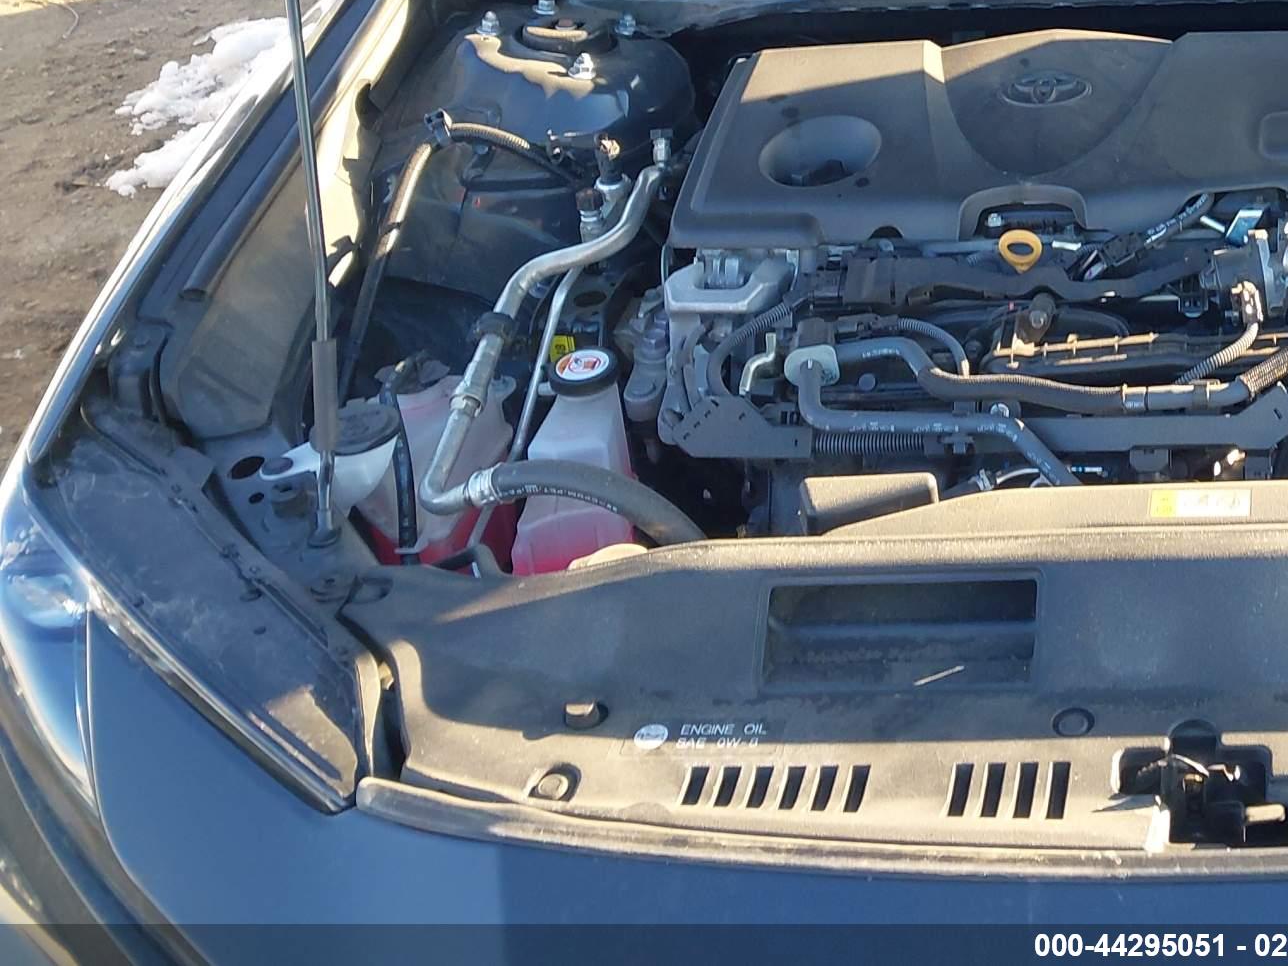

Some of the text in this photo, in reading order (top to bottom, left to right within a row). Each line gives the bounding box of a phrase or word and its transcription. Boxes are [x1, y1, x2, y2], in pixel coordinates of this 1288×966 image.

[680, 722, 767, 736] ENGINE OIL
[675, 737, 706, 749] SAE
